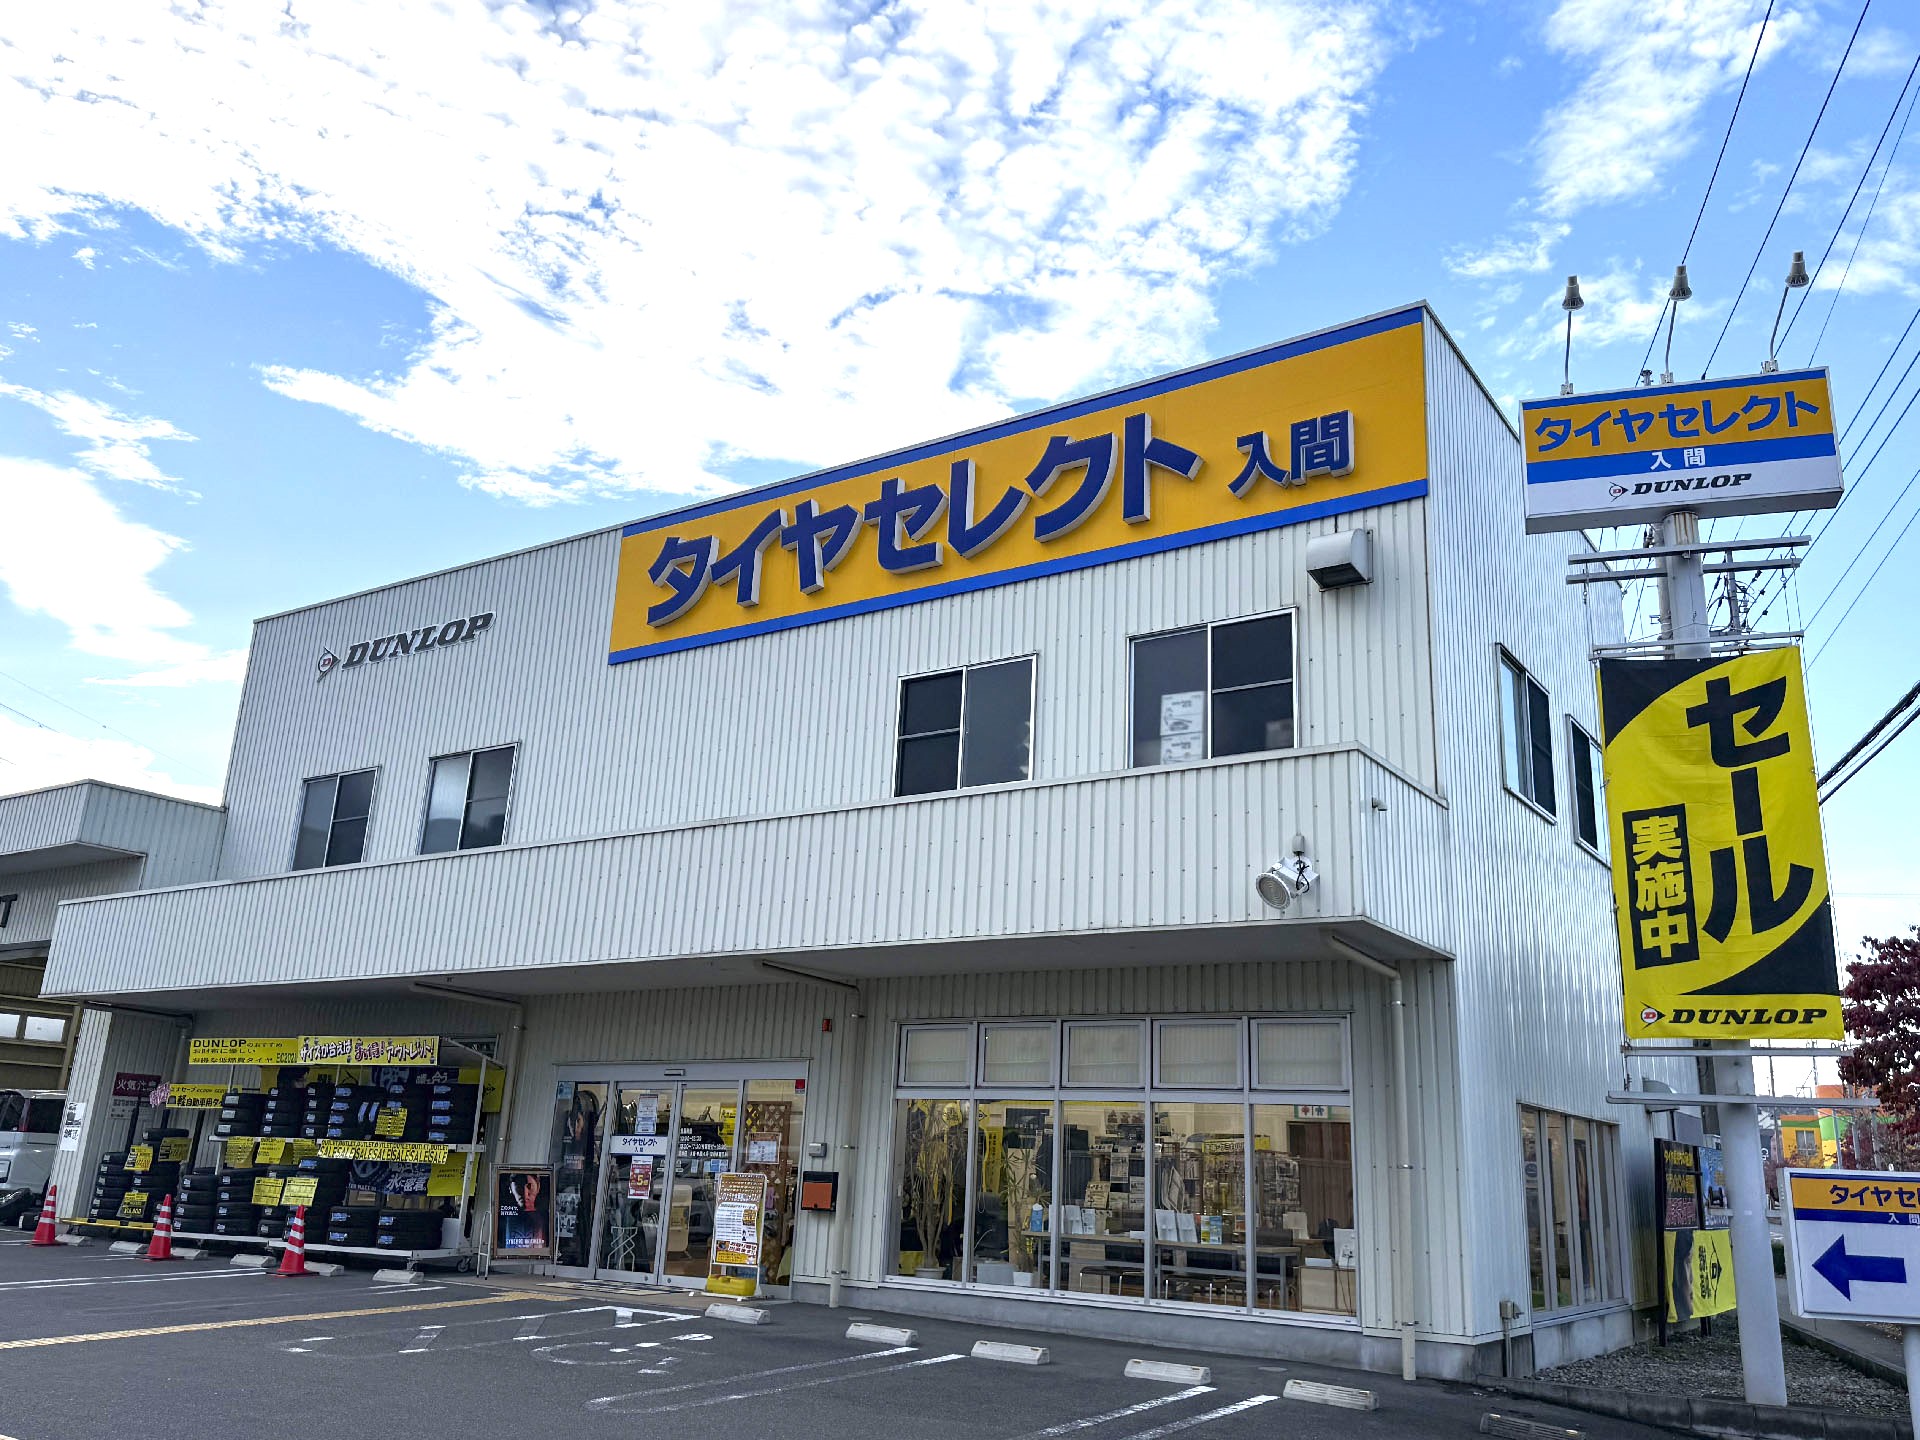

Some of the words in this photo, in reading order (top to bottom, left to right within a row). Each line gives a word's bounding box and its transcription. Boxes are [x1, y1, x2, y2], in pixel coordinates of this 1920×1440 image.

[1535, 391, 1819, 452] タイヤセレクト
[1631, 473, 1752, 496] DUNLOP
[1650, 447, 1706, 470] 入間
[647, 412, 1204, 629] タイヤセレクト
[1228, 410, 1354, 500] 入間
[342, 612, 496, 670] DUNLOP
[1686, 676, 1814, 944] セール
[1631, 815, 1690, 959] 実施中
[1668, 1008, 1828, 1024] DUNLOP
[622, 1137, 658, 1147] タイヤセレクト
